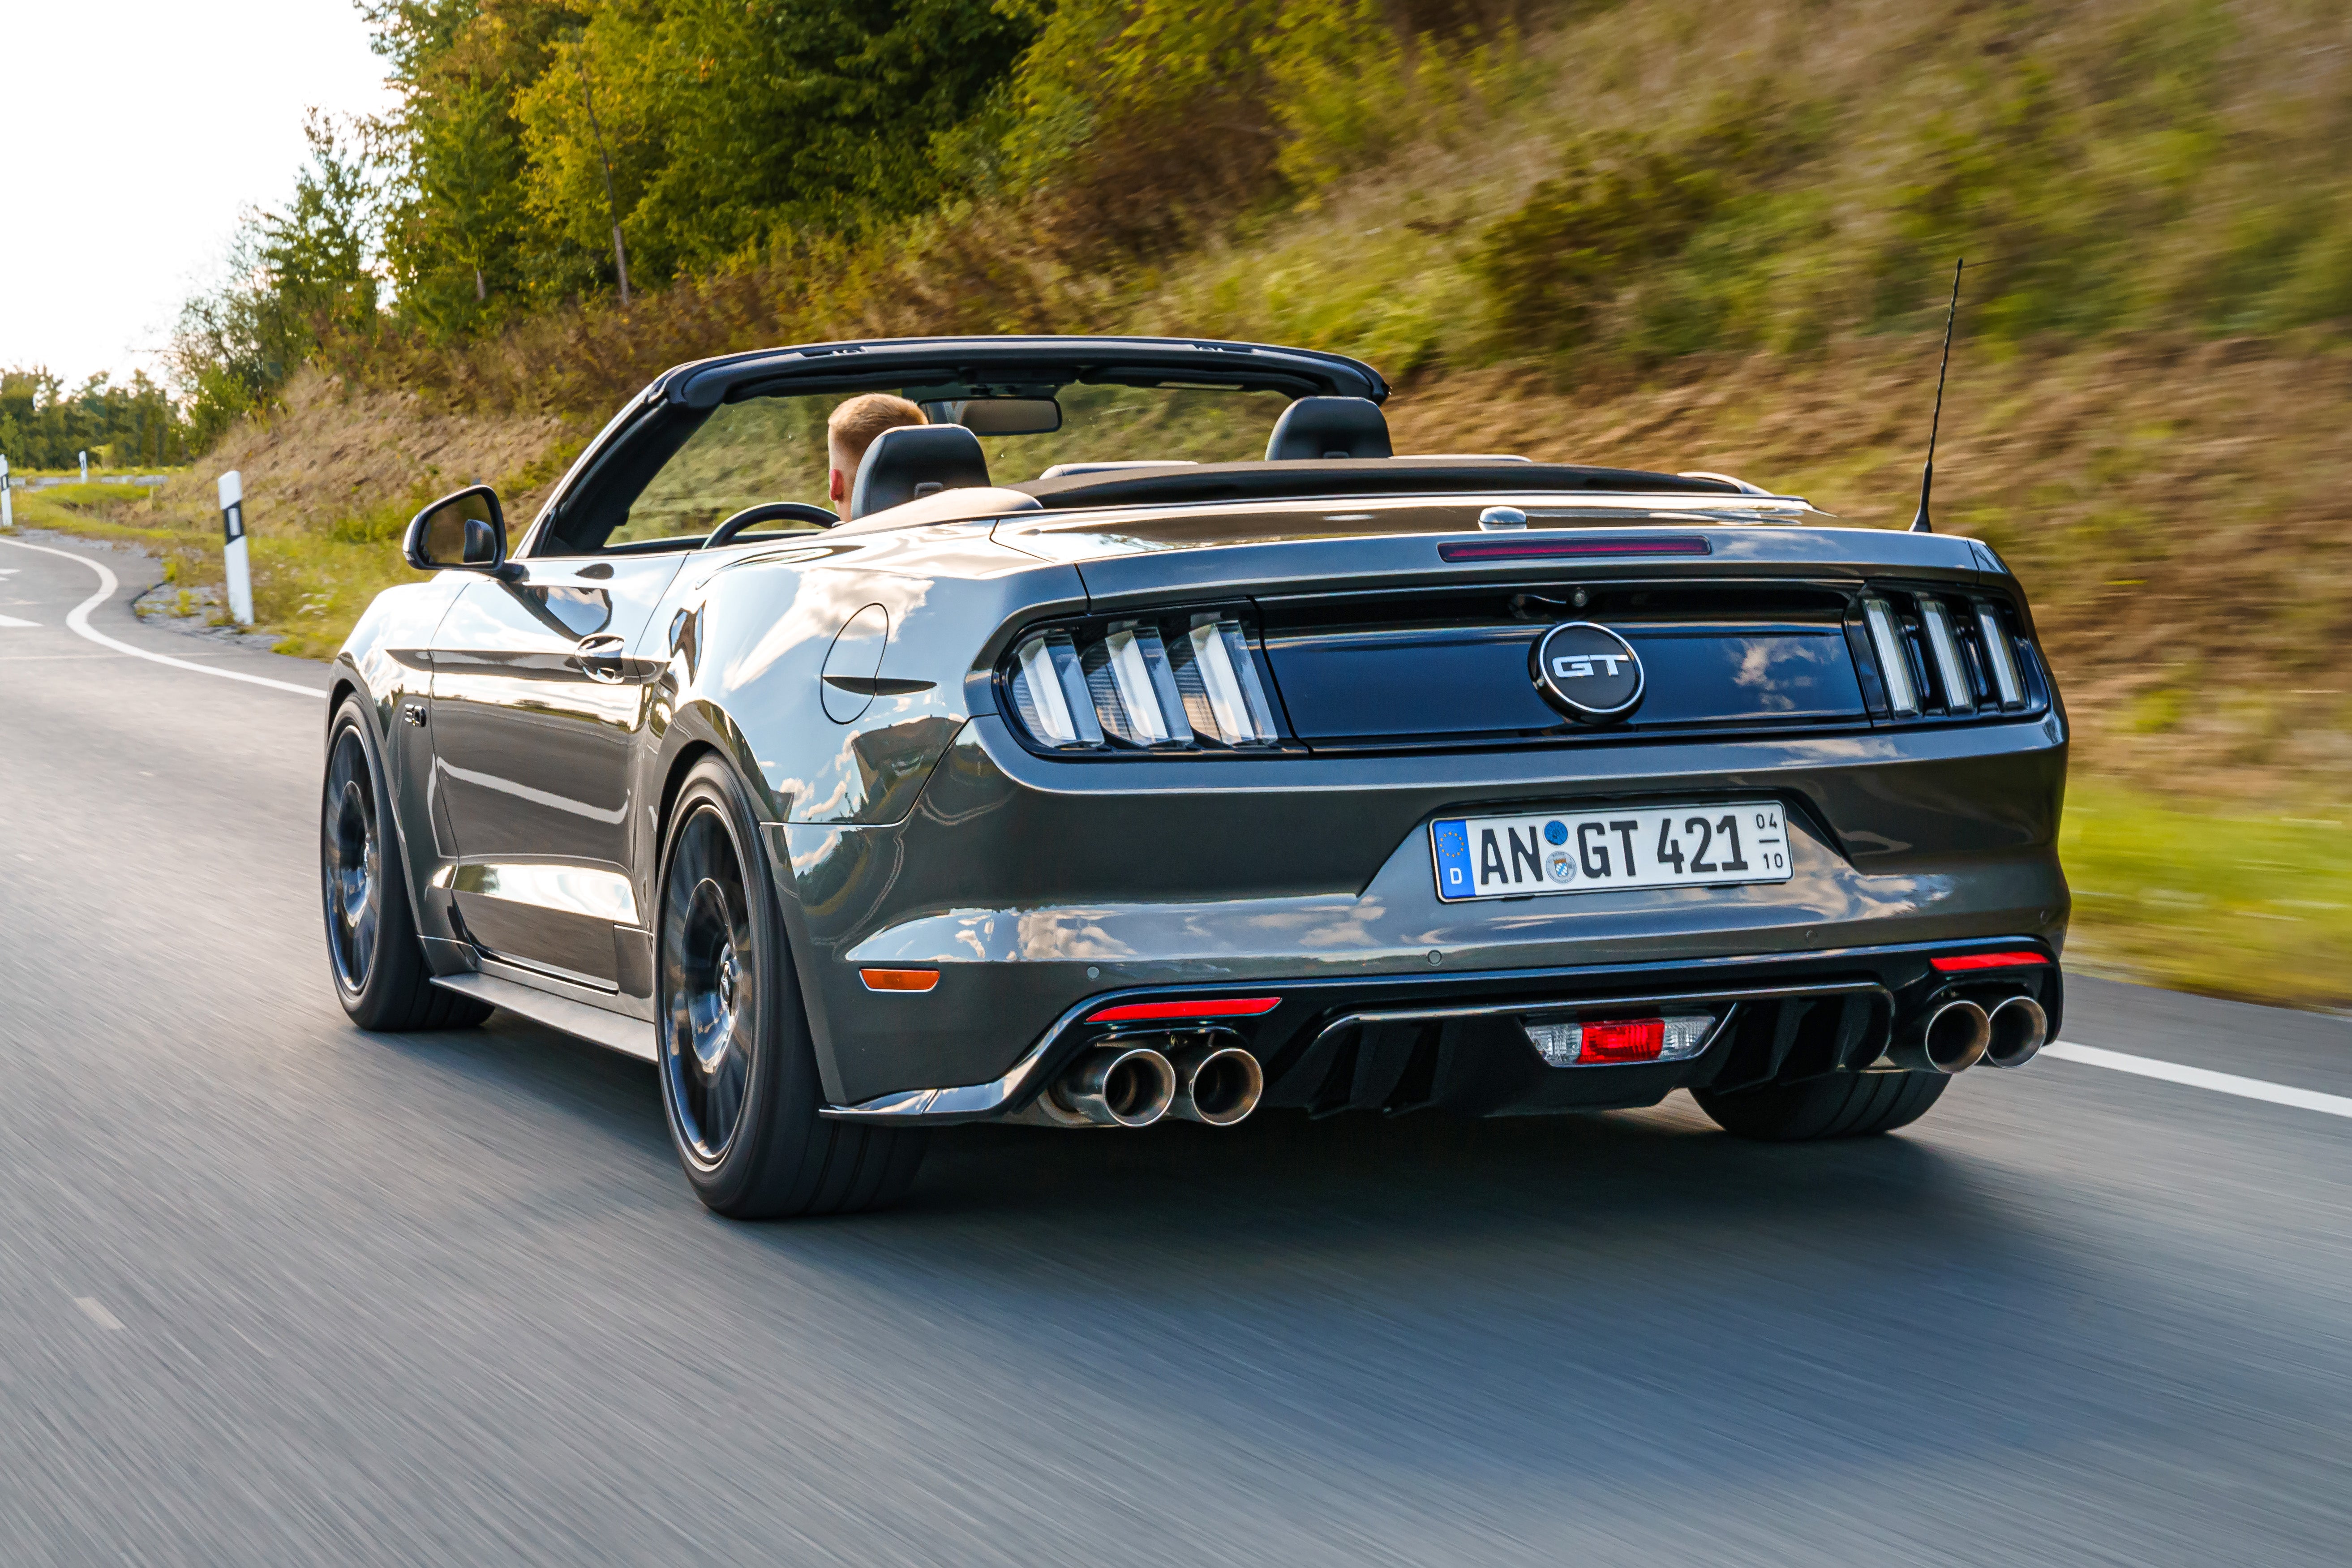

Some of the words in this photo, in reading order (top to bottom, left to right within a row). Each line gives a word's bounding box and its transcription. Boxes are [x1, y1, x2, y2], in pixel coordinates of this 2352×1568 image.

[1552, 654, 1629, 678] GT
[1756, 813, 1777, 829] 04
[1481, 825, 1543, 885] AN
[1577, 820, 1638, 878] GT
[1657, 815, 1748, 873] 421
[1764, 853, 1782, 869] 10
[1449, 868, 1462, 885] D
